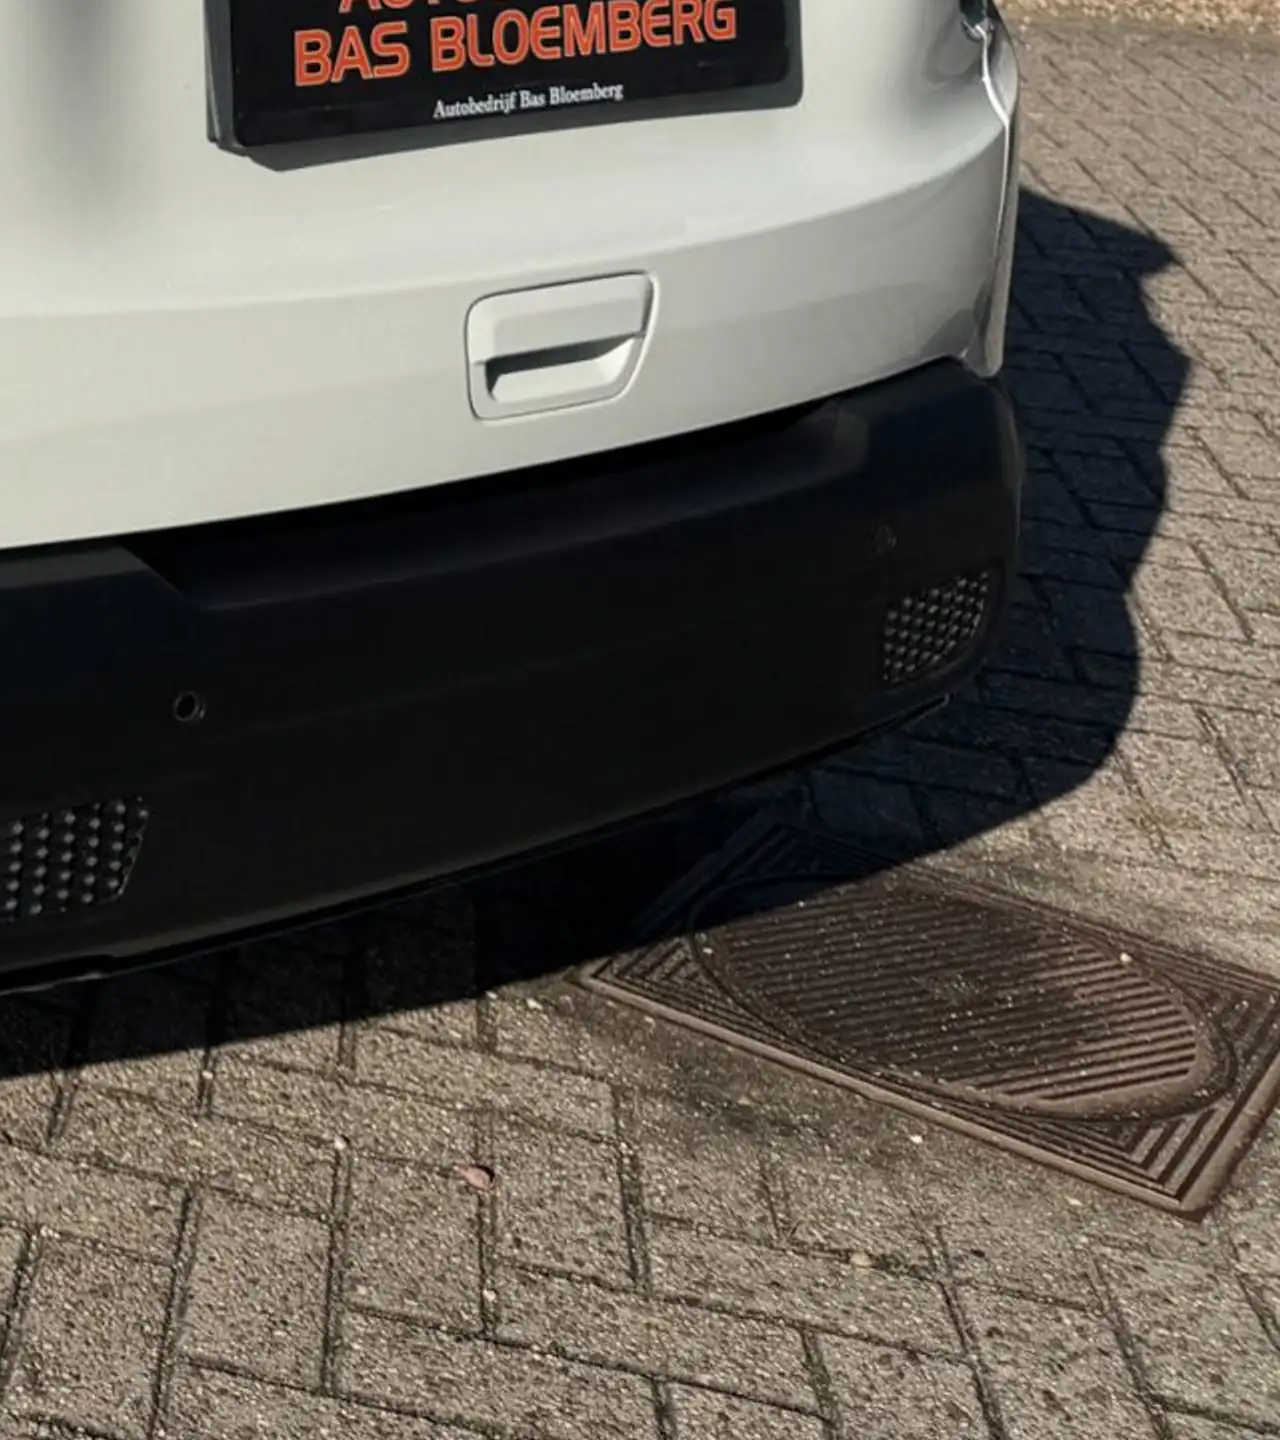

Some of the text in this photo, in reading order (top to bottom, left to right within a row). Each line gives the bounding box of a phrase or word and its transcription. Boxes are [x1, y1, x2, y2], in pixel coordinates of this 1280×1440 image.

[294, 20, 410, 87] BAS
[433, 81, 624, 120] Autobedrijf Bas Bloemberg
